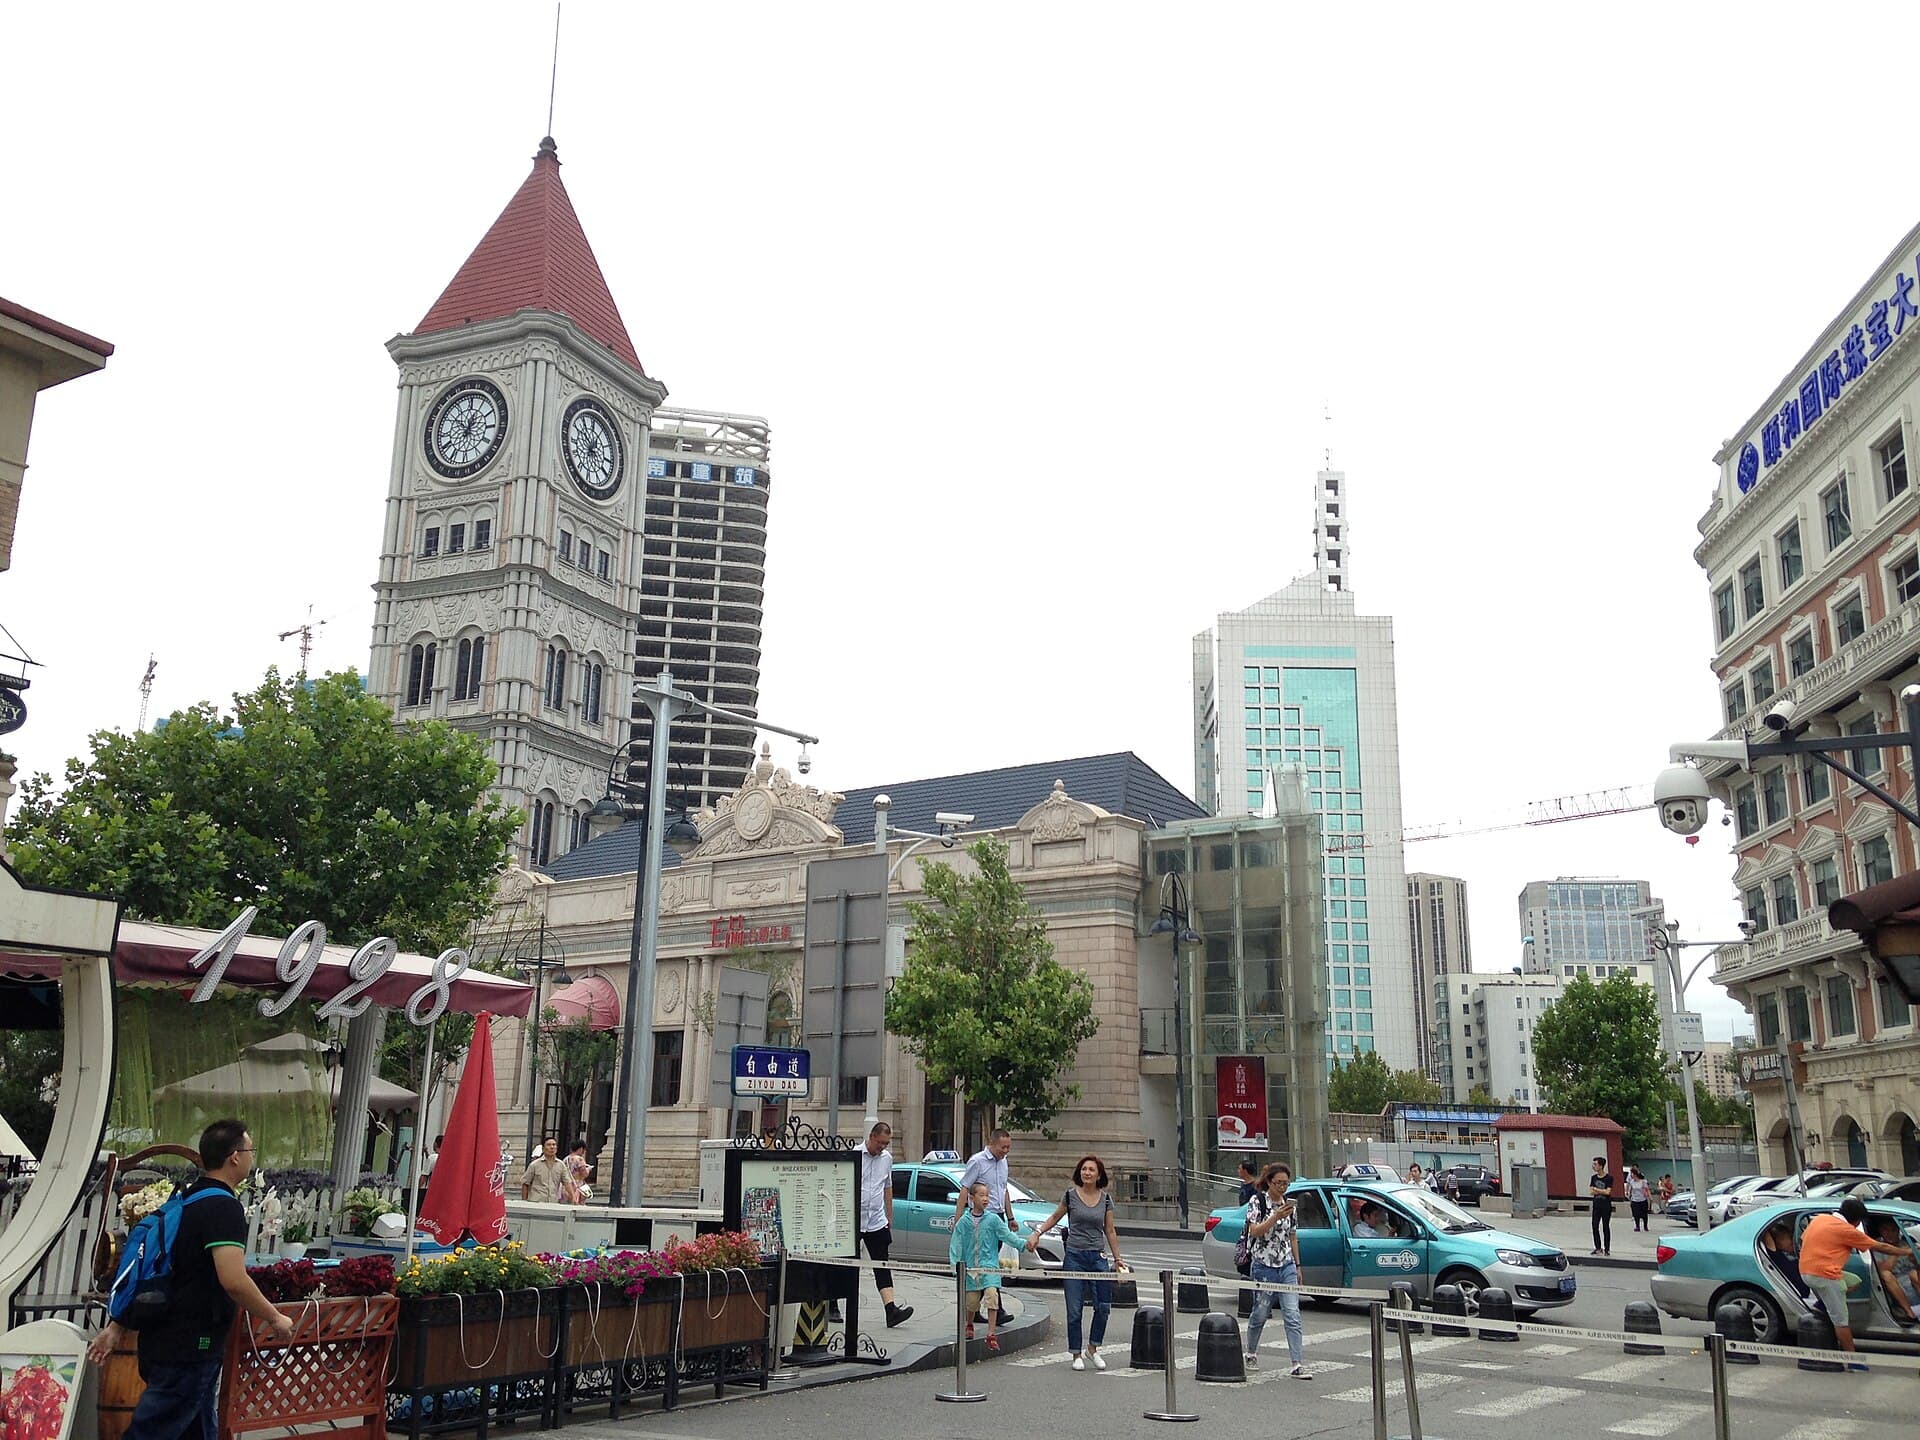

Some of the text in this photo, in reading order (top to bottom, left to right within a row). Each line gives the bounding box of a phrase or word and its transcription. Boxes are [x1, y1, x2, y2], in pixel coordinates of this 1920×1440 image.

[1761, 252, 1920, 468] 颐和国际珠宝大
[188, 905, 469, 1026] 1928
[746, 1054, 799, 1077] 自由道
[748, 1079, 797, 1089] ZIYOU DAO
